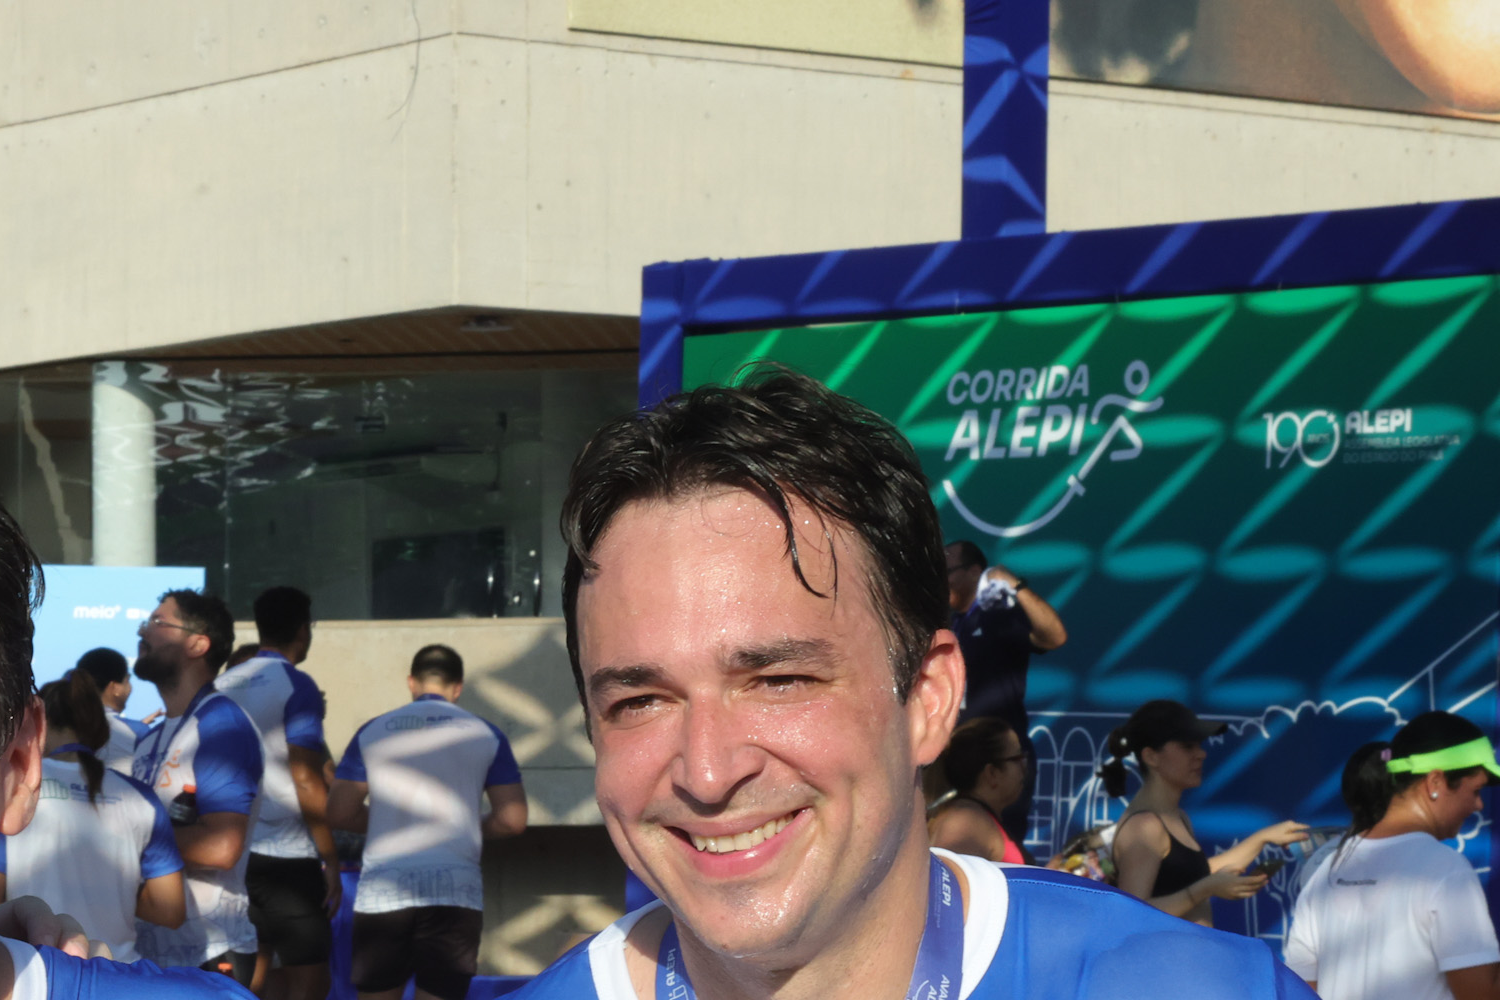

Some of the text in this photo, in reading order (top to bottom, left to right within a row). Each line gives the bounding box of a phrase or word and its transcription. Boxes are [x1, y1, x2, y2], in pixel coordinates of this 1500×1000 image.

[946, 364, 1090, 406] CORRIDA
[944, 403, 1089, 462] ALEPI
[1344, 408, 1412, 434] ALEPI
[941, 866, 951, 907] ALEPI
[665, 948, 676, 987] ALEPI
